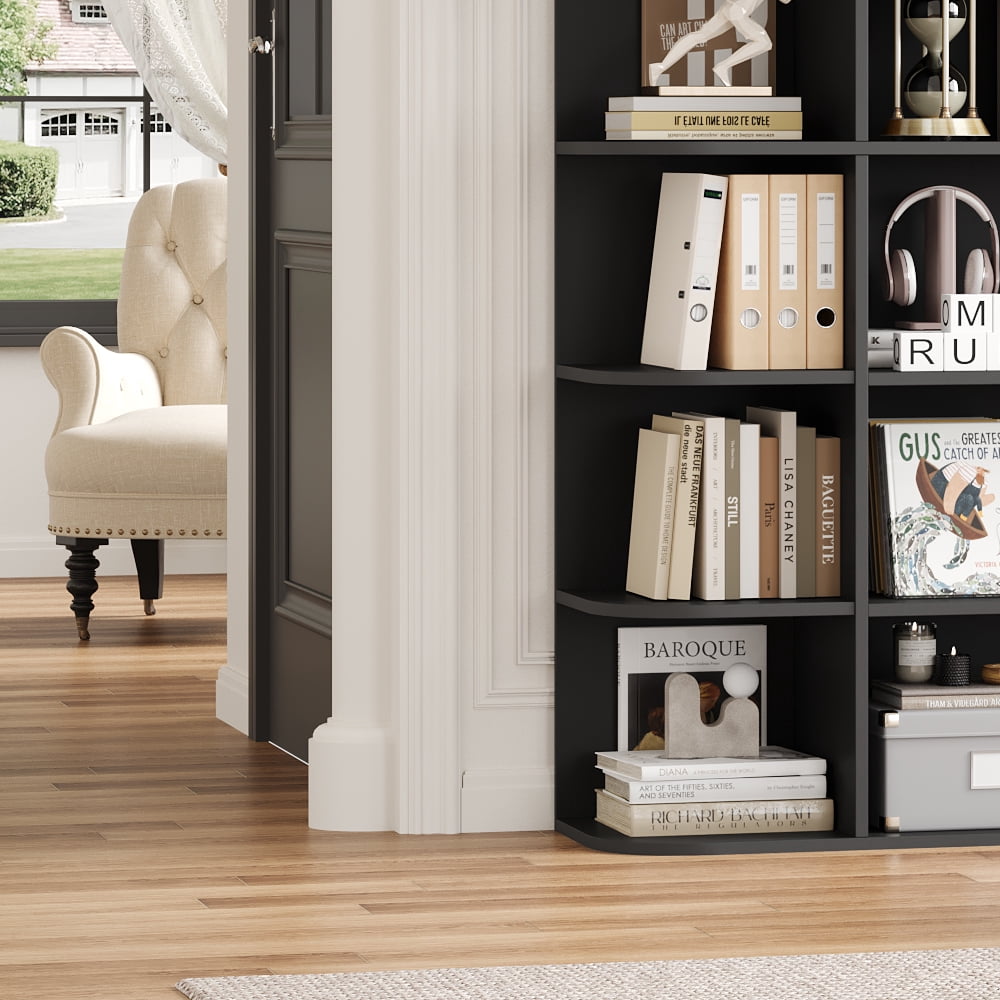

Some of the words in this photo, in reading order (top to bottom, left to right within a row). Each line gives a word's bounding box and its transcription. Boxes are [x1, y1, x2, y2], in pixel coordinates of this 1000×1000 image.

[684, 424, 692, 437] die
[695, 426, 704, 444] DAS
[899, 432, 941, 462] GUS
[944, 448, 974, 461] CATCH
[977, 448, 989, 460] OF
[692, 448, 702, 472] NEUE
[680, 463, 688, 483] stadt
[784, 458, 793, 492] LISA
[688, 474, 700, 528] FRANKFURT
[727, 496, 739, 528] STILL
[764, 503, 776, 528] Paris
[821, 475, 835, 565] BAGUETTE
[784, 500, 794, 564] CHANEY
[644, 640, 746, 660] BAROQUE
[659, 768, 689, 777] DIANA
[658, 791, 695, 799] SEVENTIES
[652, 809, 725, 825] RICHARD
